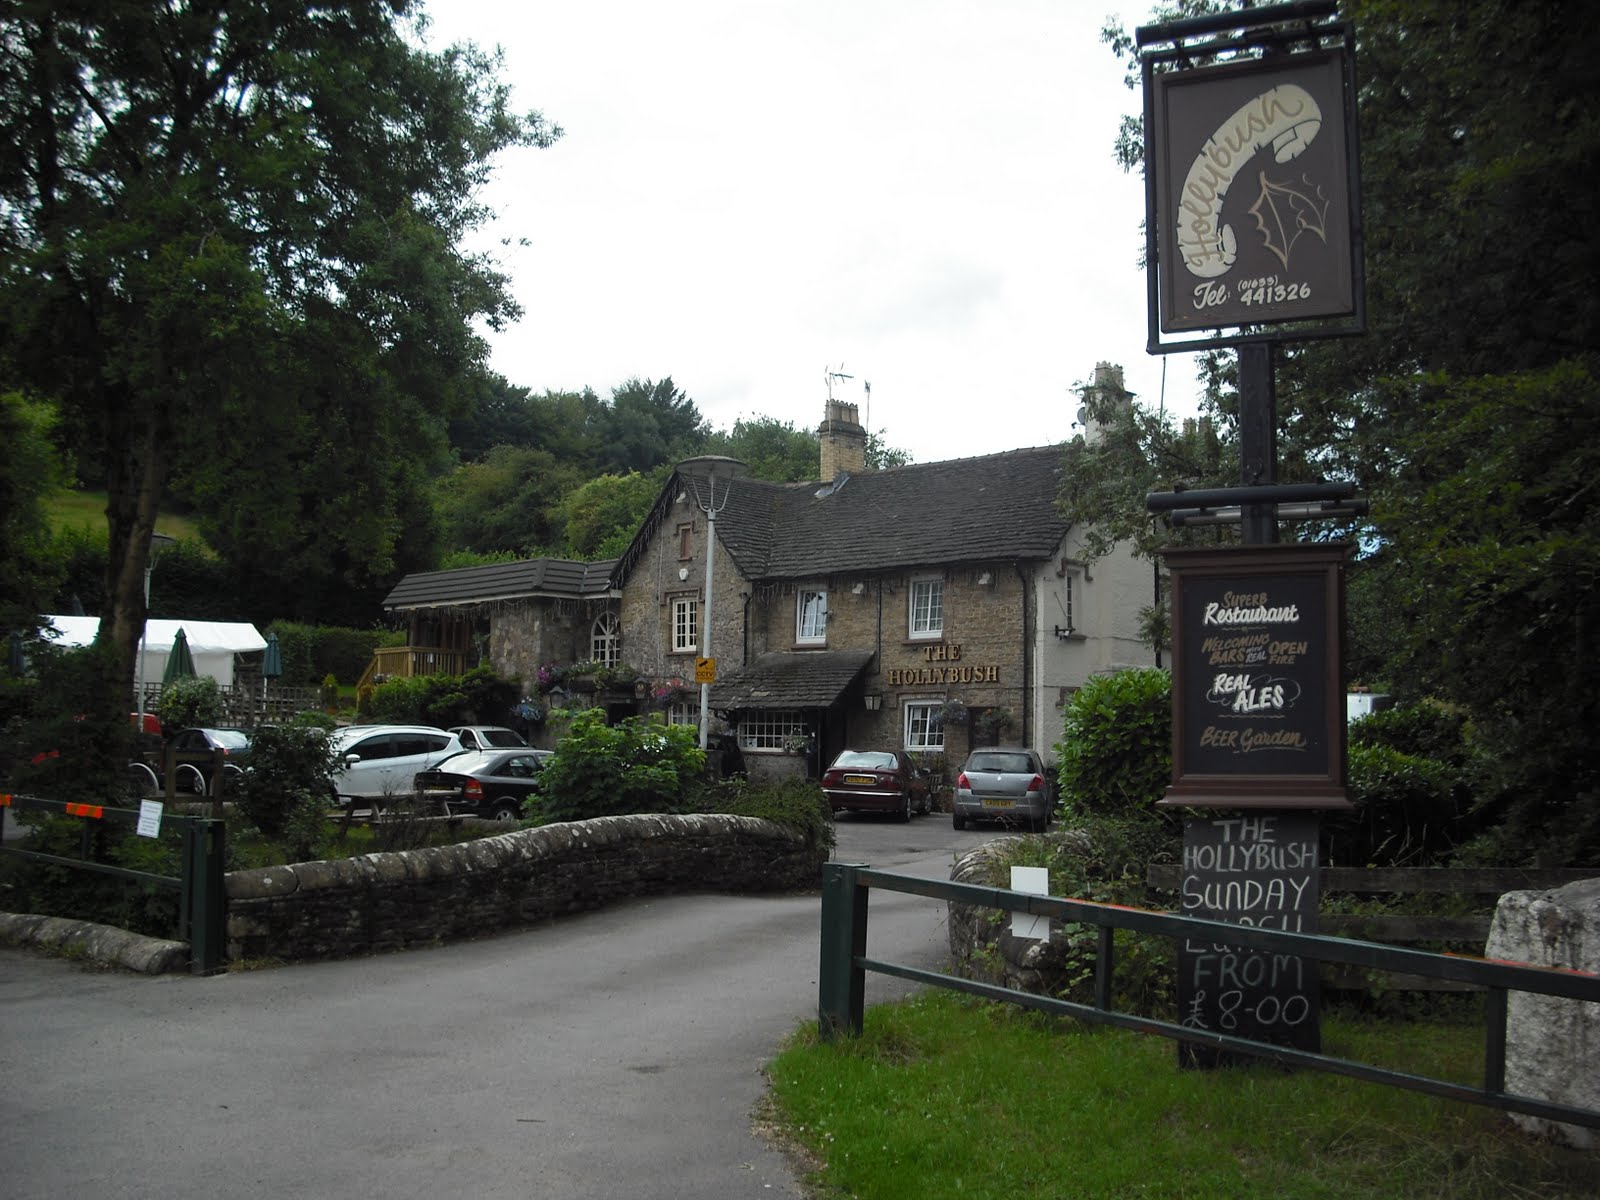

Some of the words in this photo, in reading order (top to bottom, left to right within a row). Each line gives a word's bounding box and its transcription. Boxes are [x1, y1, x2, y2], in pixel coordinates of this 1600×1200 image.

[1181, 95, 1304, 268] Hollybush
[1240, 282, 1311, 306] 441326
[1204, 602, 1299, 624] Restaurant
[924, 644, 961, 662] THE
[1208, 648, 1246, 665] BARS
[1268, 641, 1308, 655] OPEN
[1245, 651, 1267, 663] REAL
[1268, 655, 1296, 664] FIRE
[888, 665, 999, 685] HOLLYBUSH
[1213, 673, 1251, 694] REAL
[1232, 684, 1285, 713] ALES
[1200, 726, 1239, 747] BEER
[1239, 728, 1307, 752] Garden
[1212, 817, 1278, 843] THE
[1184, 842, 1318, 872] HOLLYBUSH
[1194, 954, 1303, 989] FROM
